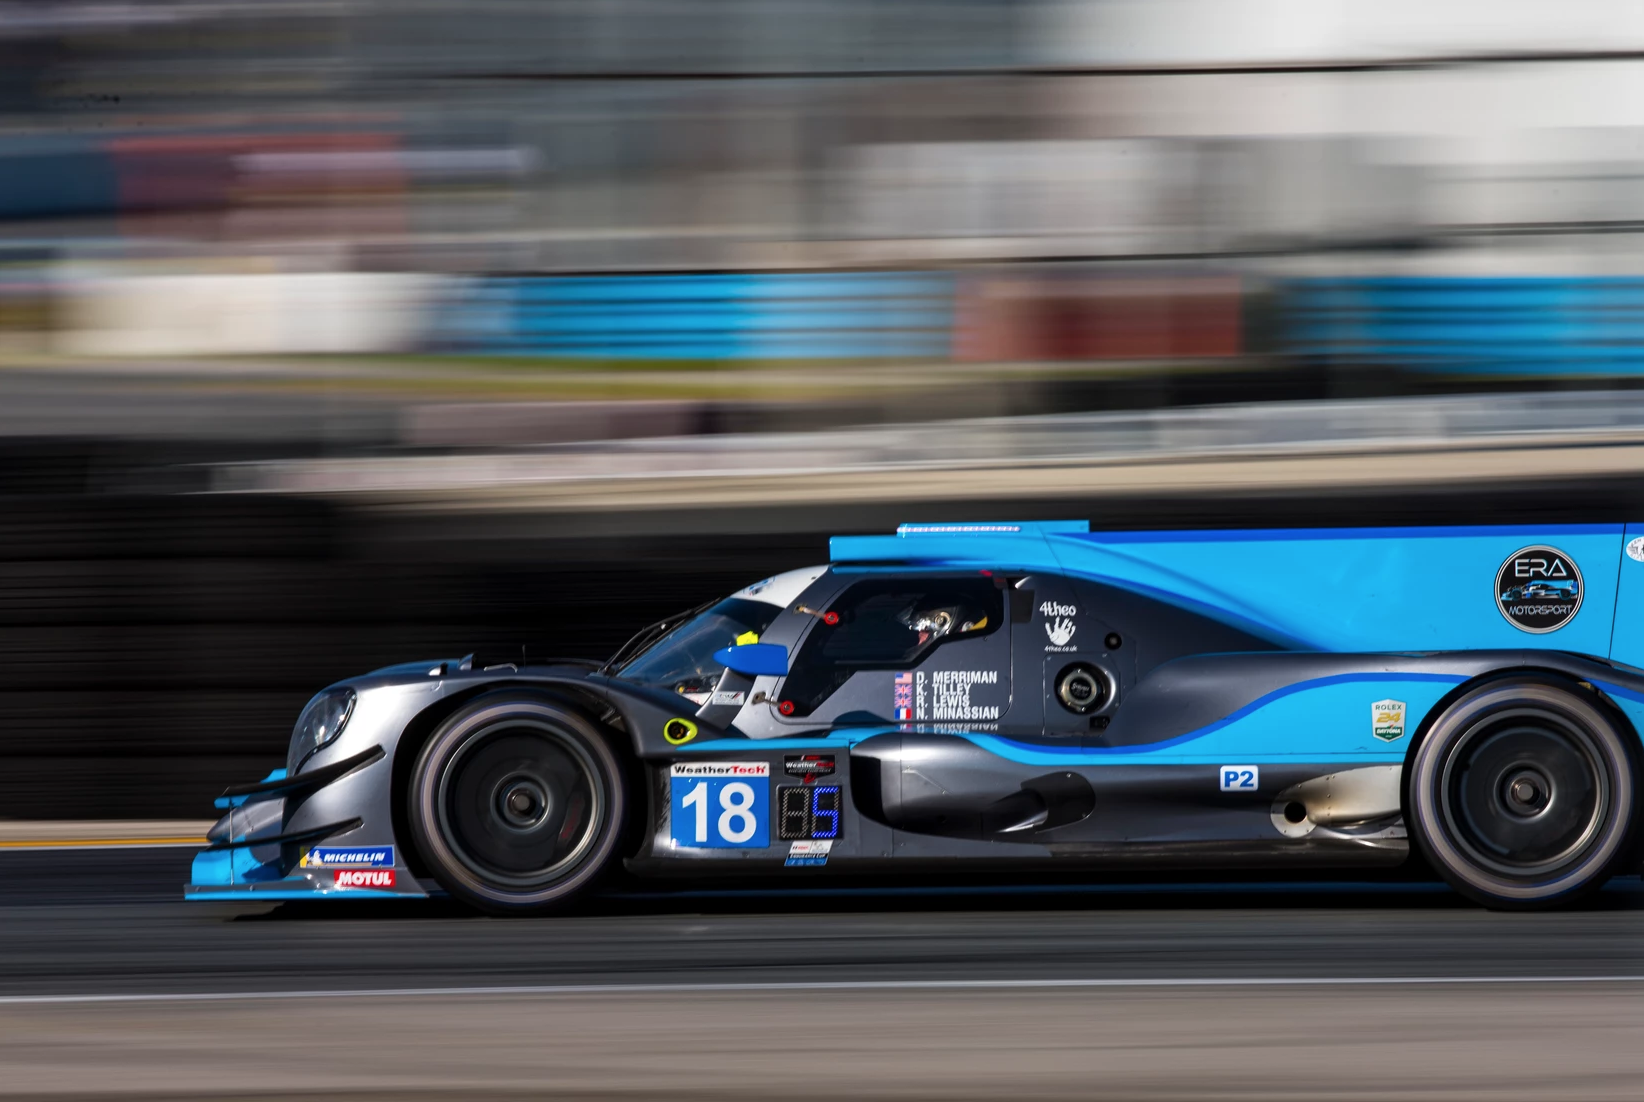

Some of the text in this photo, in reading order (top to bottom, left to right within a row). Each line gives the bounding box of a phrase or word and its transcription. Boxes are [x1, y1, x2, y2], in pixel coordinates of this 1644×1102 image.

[1514, 558, 1568, 577] ERA
[1039, 601, 1077, 617] 4theo
[1508, 604, 1573, 616] MOTORSPORT
[933, 670, 998, 684] MERRIMAN
[932, 683, 971, 695] TILLEY
[933, 695, 970, 708] LEWIS
[933, 706, 999, 720] MINASSIAN
[1376, 711, 1402, 723] 24
[674, 765, 766, 775] WeatherTech
[1224, 770, 1254, 788] P2
[682, 781, 757, 844] 18
[323, 852, 386, 863] MICHELIN
[338, 871, 392, 886] MOTUL
